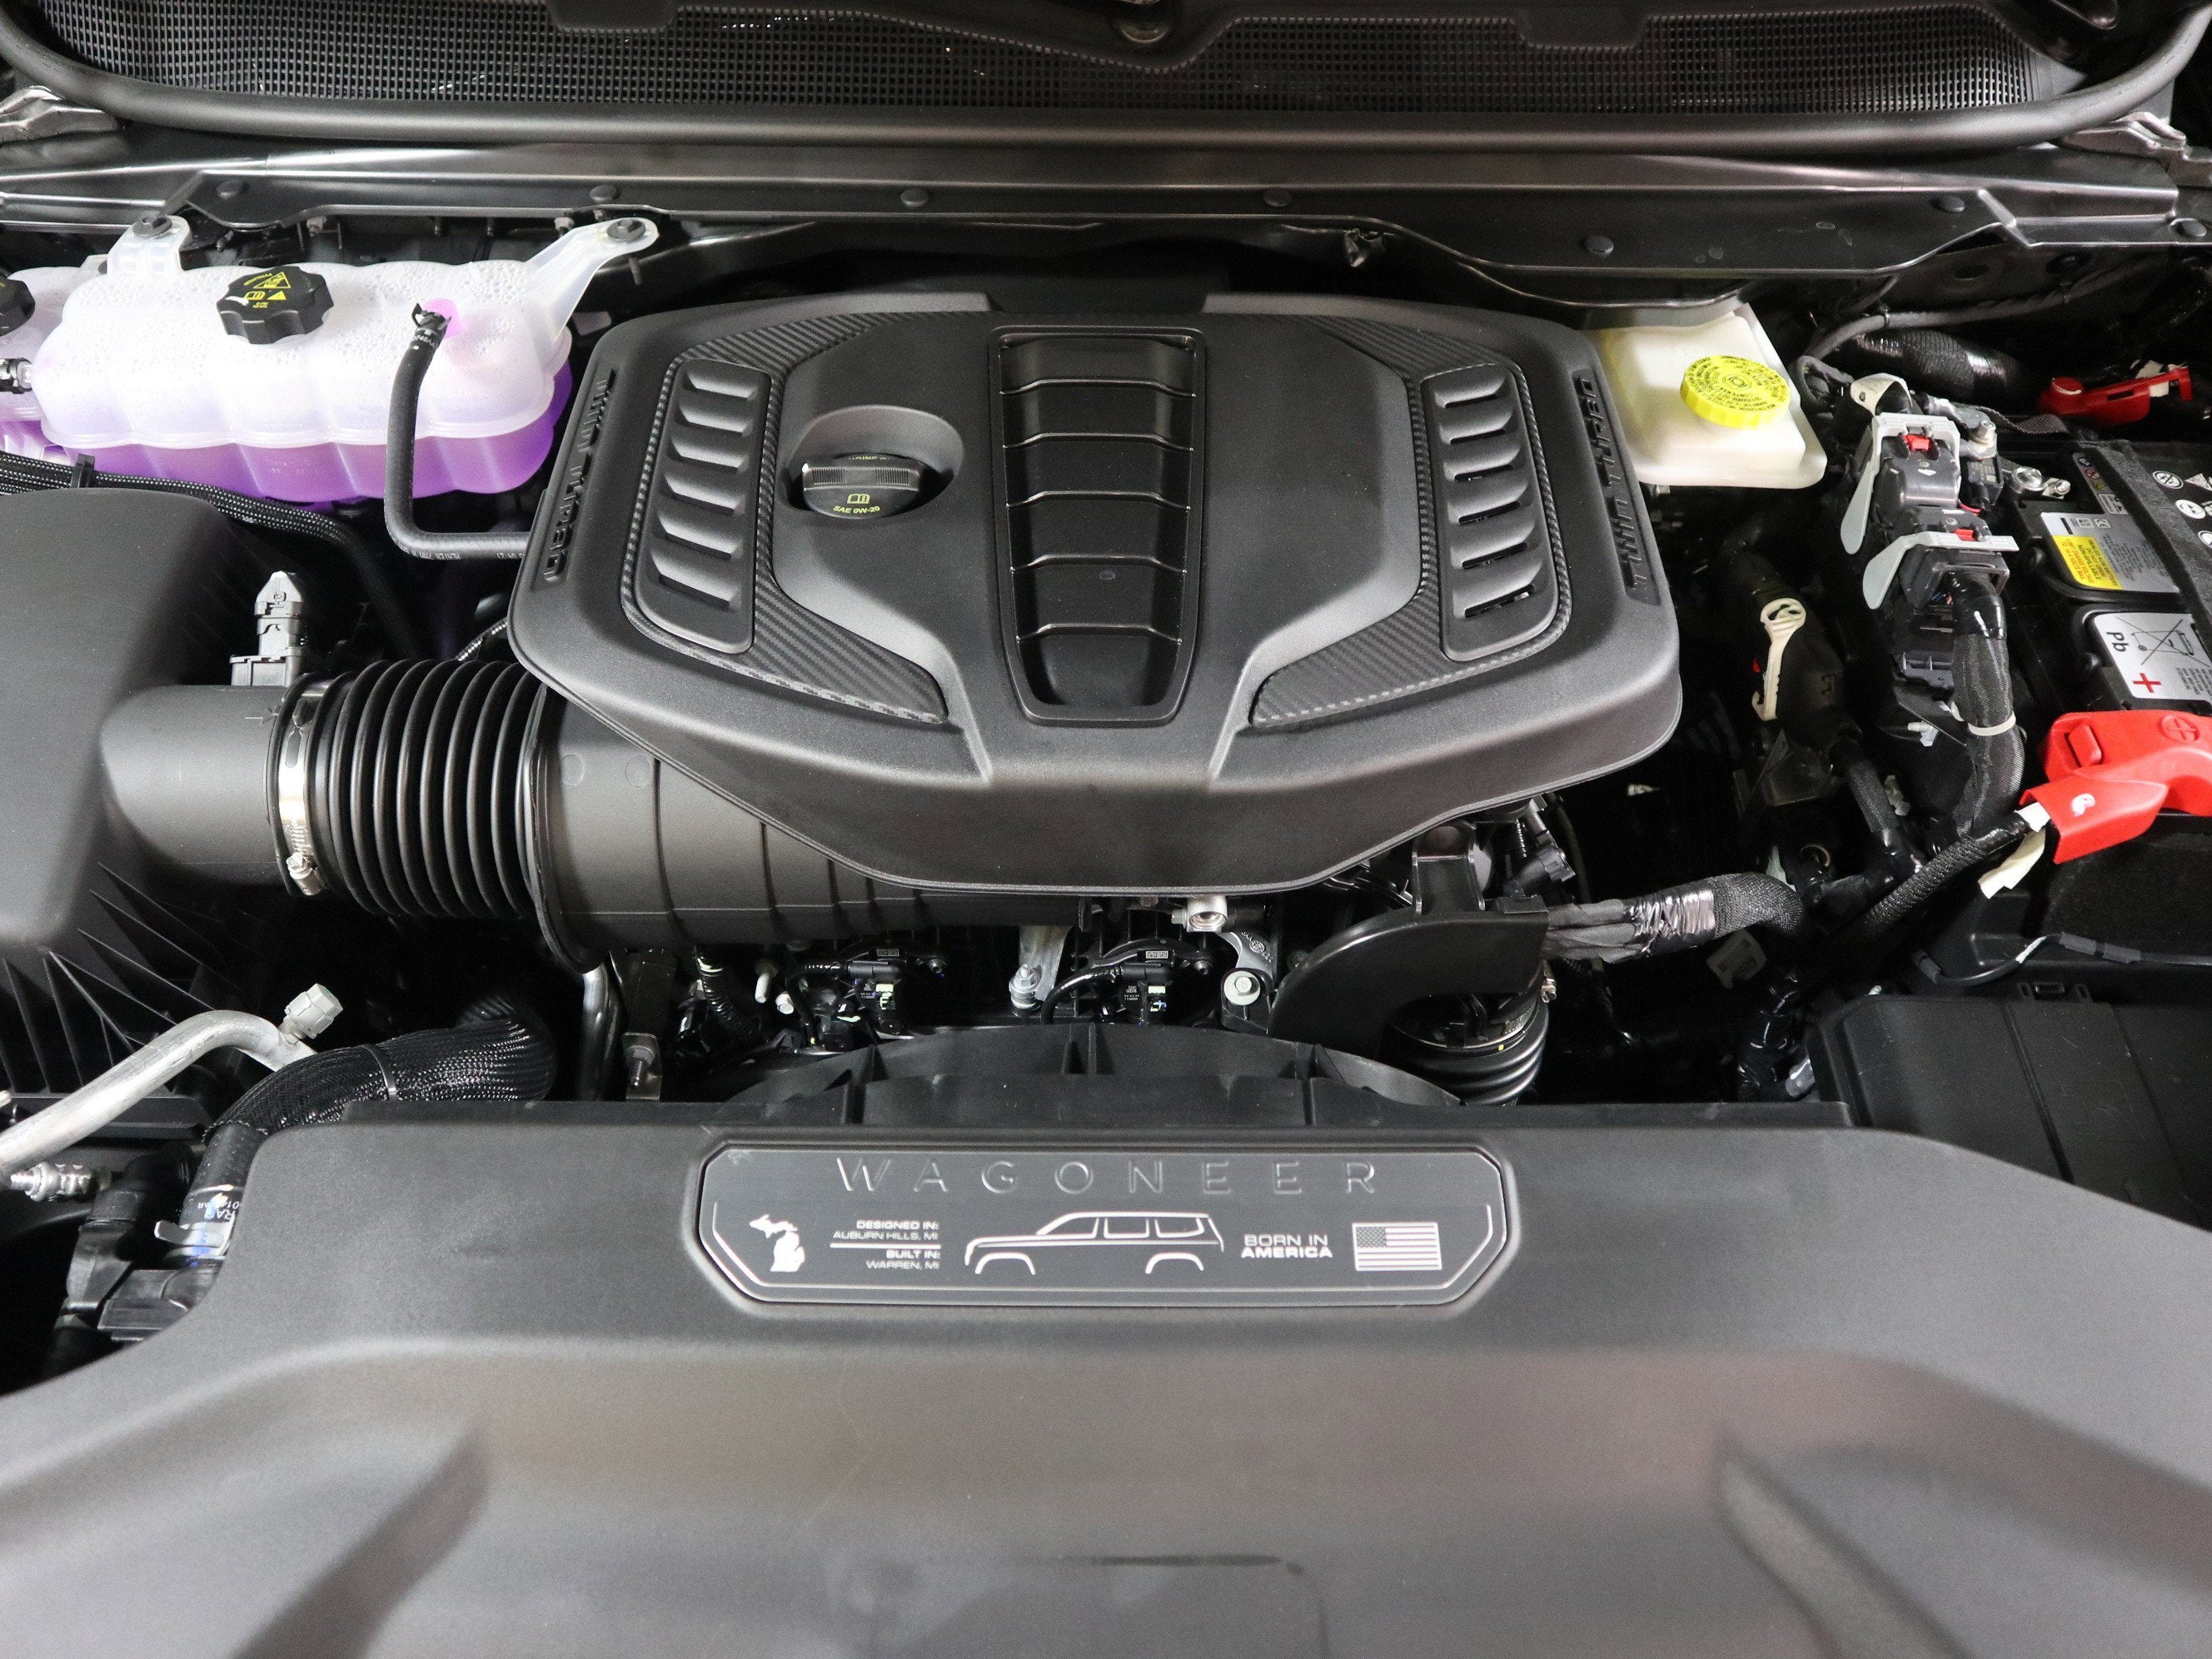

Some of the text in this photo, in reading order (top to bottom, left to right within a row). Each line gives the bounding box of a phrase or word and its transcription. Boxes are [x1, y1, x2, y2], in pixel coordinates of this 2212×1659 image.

[1573, 376, 1648, 590] TWIN TURBO
[833, 506, 880, 514] SAE 0W-20
[543, 452, 593, 582] TURBO
[2106, 631, 2130, 653] Pb
[835, 1157, 1376, 1196] WAGONEER
[856, 1220, 939, 1230] DESIGNED IN:
[833, 1230, 939, 1241] AUBURN HILLS, MI
[1244, 1234, 1328, 1246] BORN IN
[886, 1249, 941, 1259] BUILT IN:
[1241, 1247, 1333, 1258] AMERICA
[866, 1260, 939, 1270] WARREN, MI
